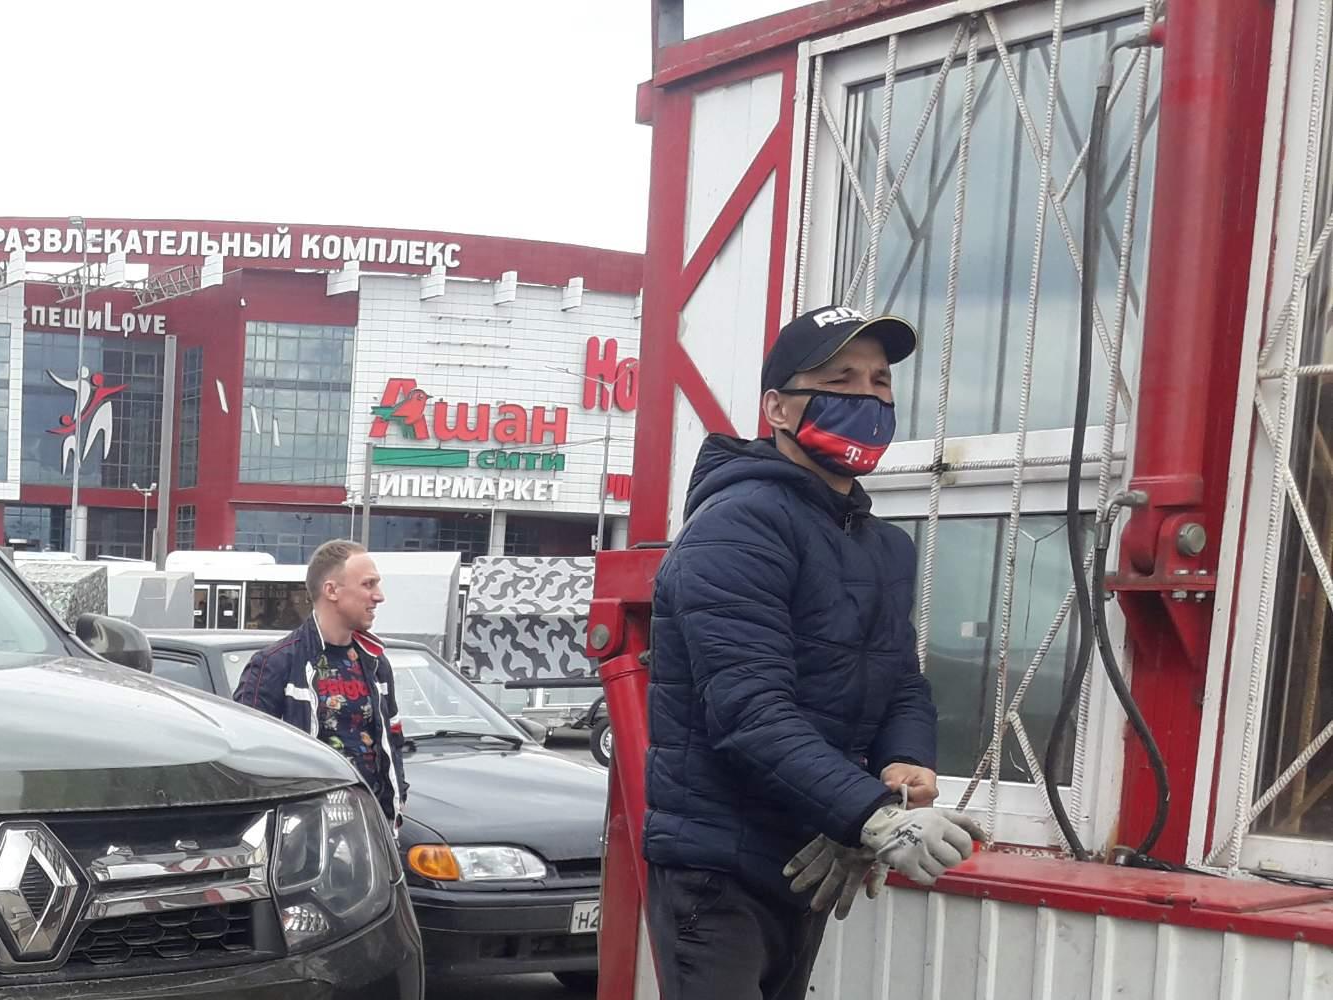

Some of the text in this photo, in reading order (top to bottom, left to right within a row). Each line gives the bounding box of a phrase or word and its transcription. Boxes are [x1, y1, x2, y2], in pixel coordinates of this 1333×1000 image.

[301, 232, 461, 267] КОМПЛЕКС
[583, 336, 638, 413] Ho
[368, 378, 568, 444] Ашан
